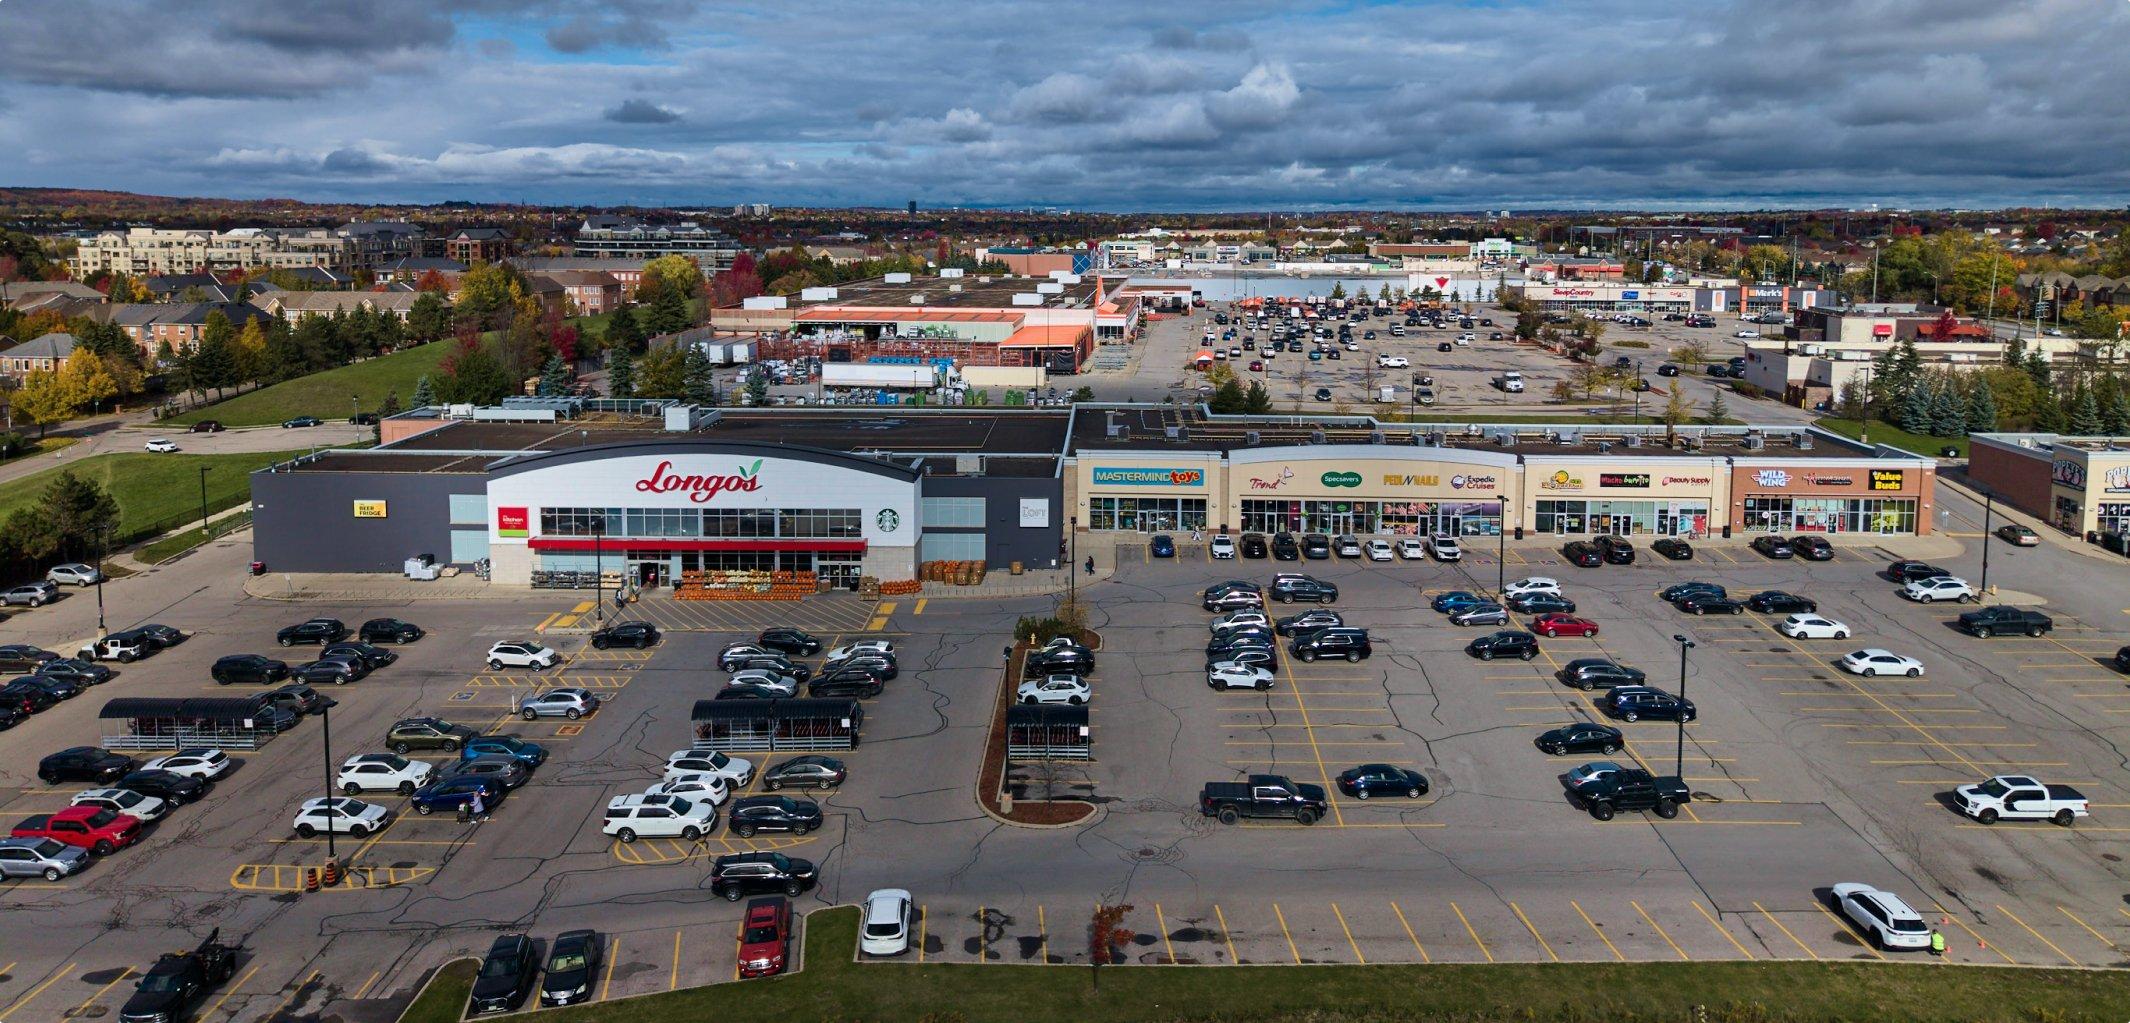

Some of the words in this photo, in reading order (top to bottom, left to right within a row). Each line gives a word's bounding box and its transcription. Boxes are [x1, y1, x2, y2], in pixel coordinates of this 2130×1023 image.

[1756, 289, 1782, 297] Mark's
[1096, 471, 1170, 482] MASTERMIND
[1170, 469, 1200, 485] toys
[1759, 469, 1785, 479] WILD
[1873, 471, 1902, 480] Value
[1324, 475, 1359, 484] Specsavers
[1414, 475, 1439, 487] NAILS
[1467, 475, 1495, 484] Expedia
[1690, 477, 1711, 485] Supply
[1758, 478, 1786, 488] WING
[1467, 482, 1495, 490] Cruises
[1875, 481, 1901, 490] Buds
